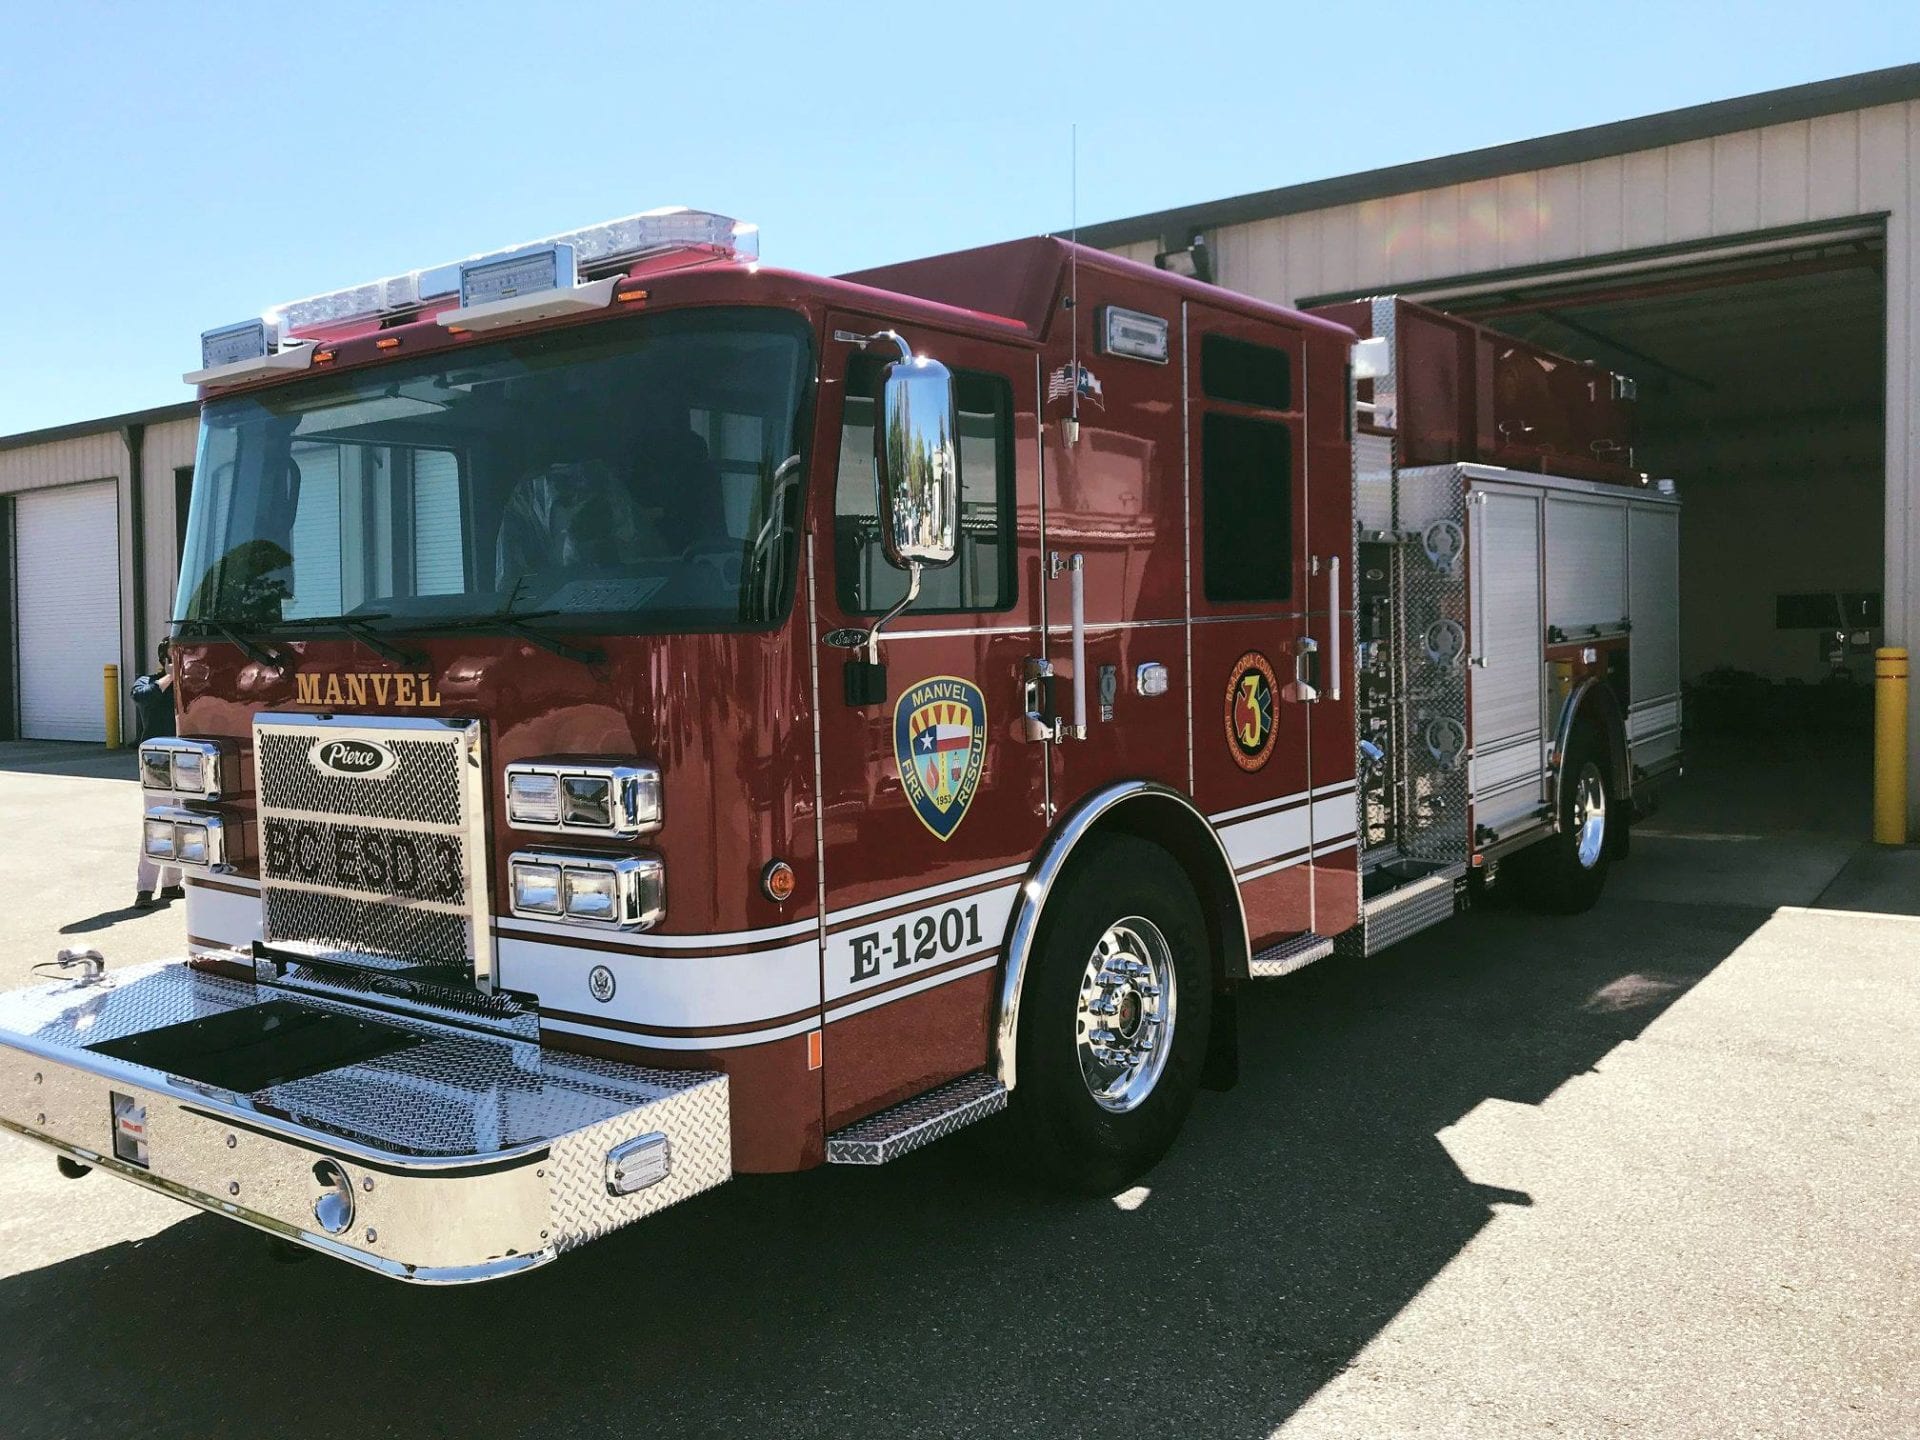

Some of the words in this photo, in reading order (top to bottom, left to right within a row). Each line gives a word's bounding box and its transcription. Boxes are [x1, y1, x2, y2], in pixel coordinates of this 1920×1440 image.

[294, 672, 441, 707] MANVEL
[911, 682, 969, 708] MANVEL
[1255, 655, 1278, 694] COUNTY
[1244, 674, 1261, 747] 3
[328, 742, 375, 768] Pierce
[957, 725, 984, 807] RESCUE
[902, 758, 925, 805] FIRE
[935, 794, 953, 806] 1953
[266, 823, 321, 878] BC
[334, 828, 419, 891] ESD
[435, 840, 460, 897] 3
[848, 903, 983, 984] E-1201
